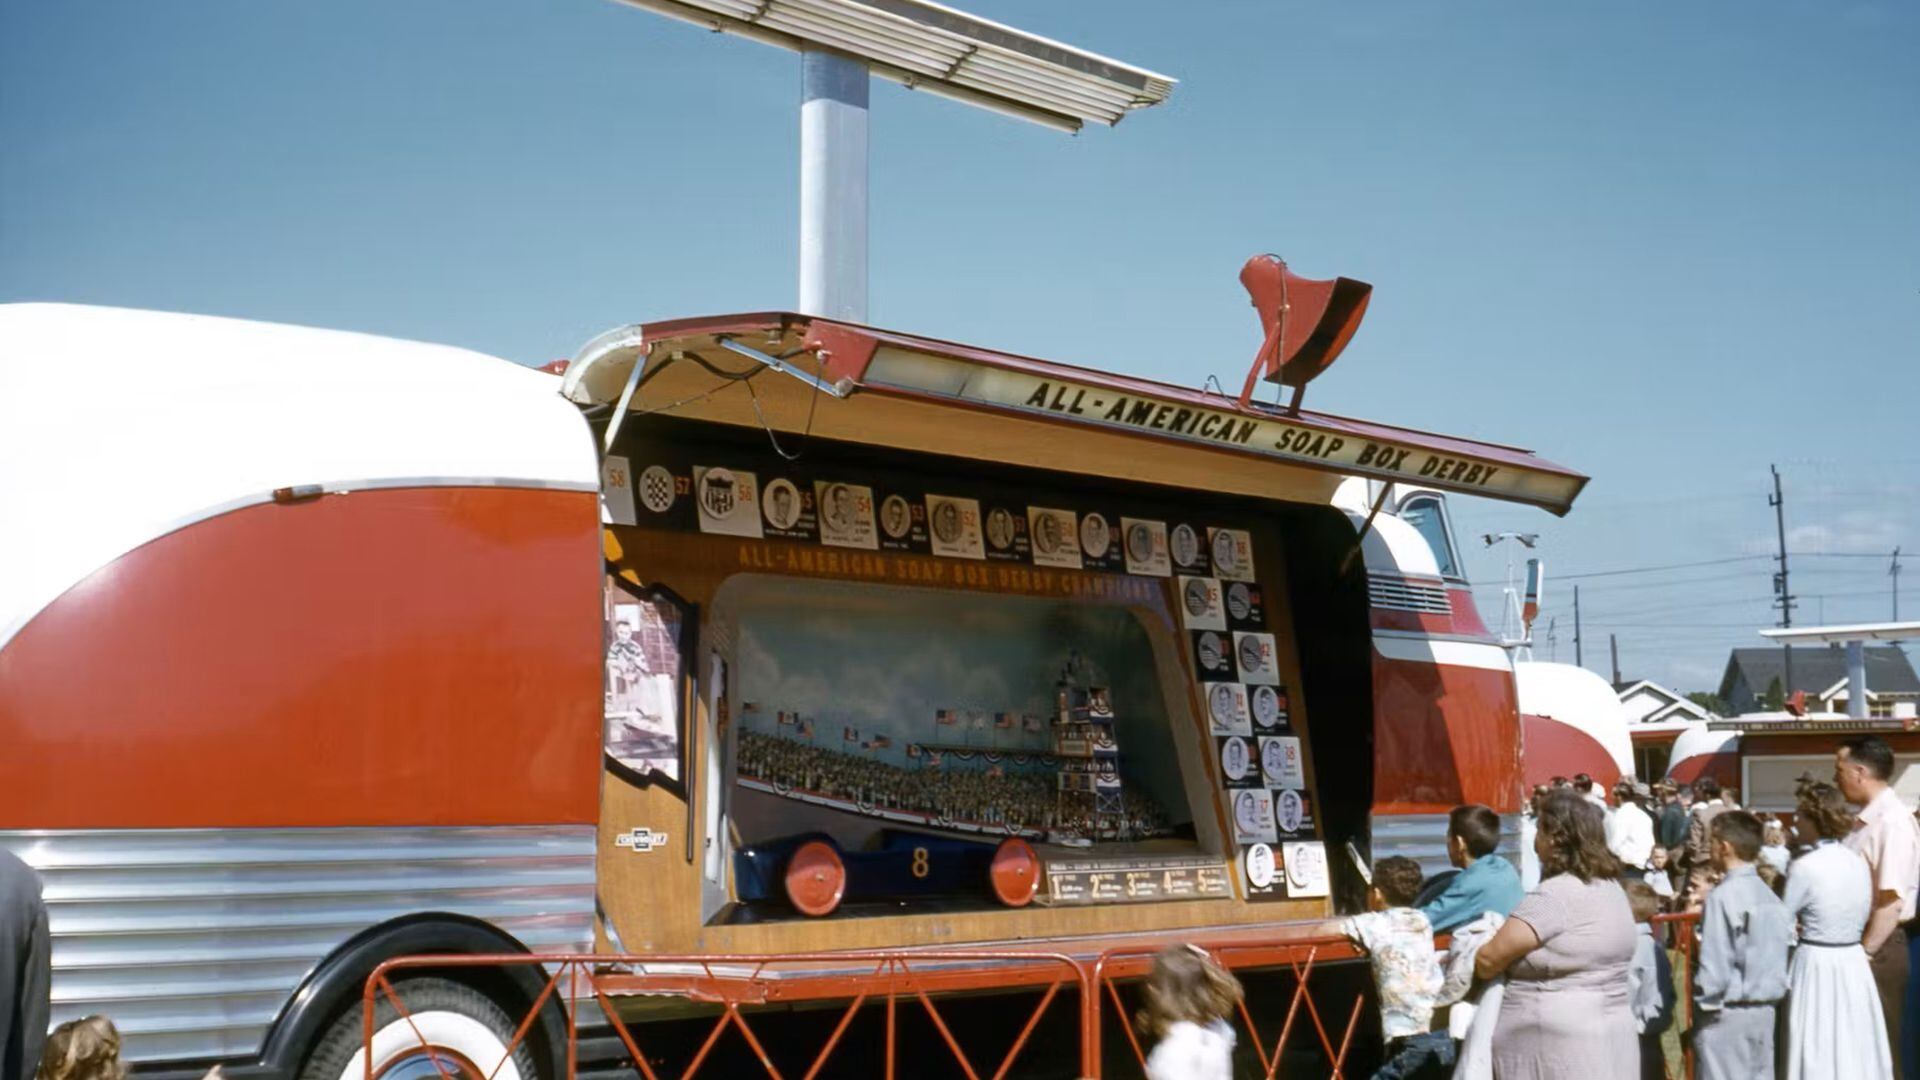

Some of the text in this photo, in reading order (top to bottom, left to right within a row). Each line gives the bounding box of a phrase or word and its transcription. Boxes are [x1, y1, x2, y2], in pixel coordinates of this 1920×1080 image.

[1026, 383, 1498, 485] ALL-AMERICAN SOAP BOX DERBY
[609, 469, 625, 487] 58
[675, 476, 691, 495] 57
[738, 483, 752, 502] 56
[855, 493, 872, 513] 54
[911, 503, 924, 521] 53
[739, 546, 885, 578] ALL-AMERICAN
[897, 560, 943, 583] SOAP
[954, 564, 988, 585] BOX
[912, 847, 929, 878] 8
[1052, 875, 1061, 899] 1
[1090, 874, 1100, 898] 2
[1126, 872, 1136, 896] 3
[1163, 871, 1173, 894] 4
[1197, 869, 1207, 892] 5
